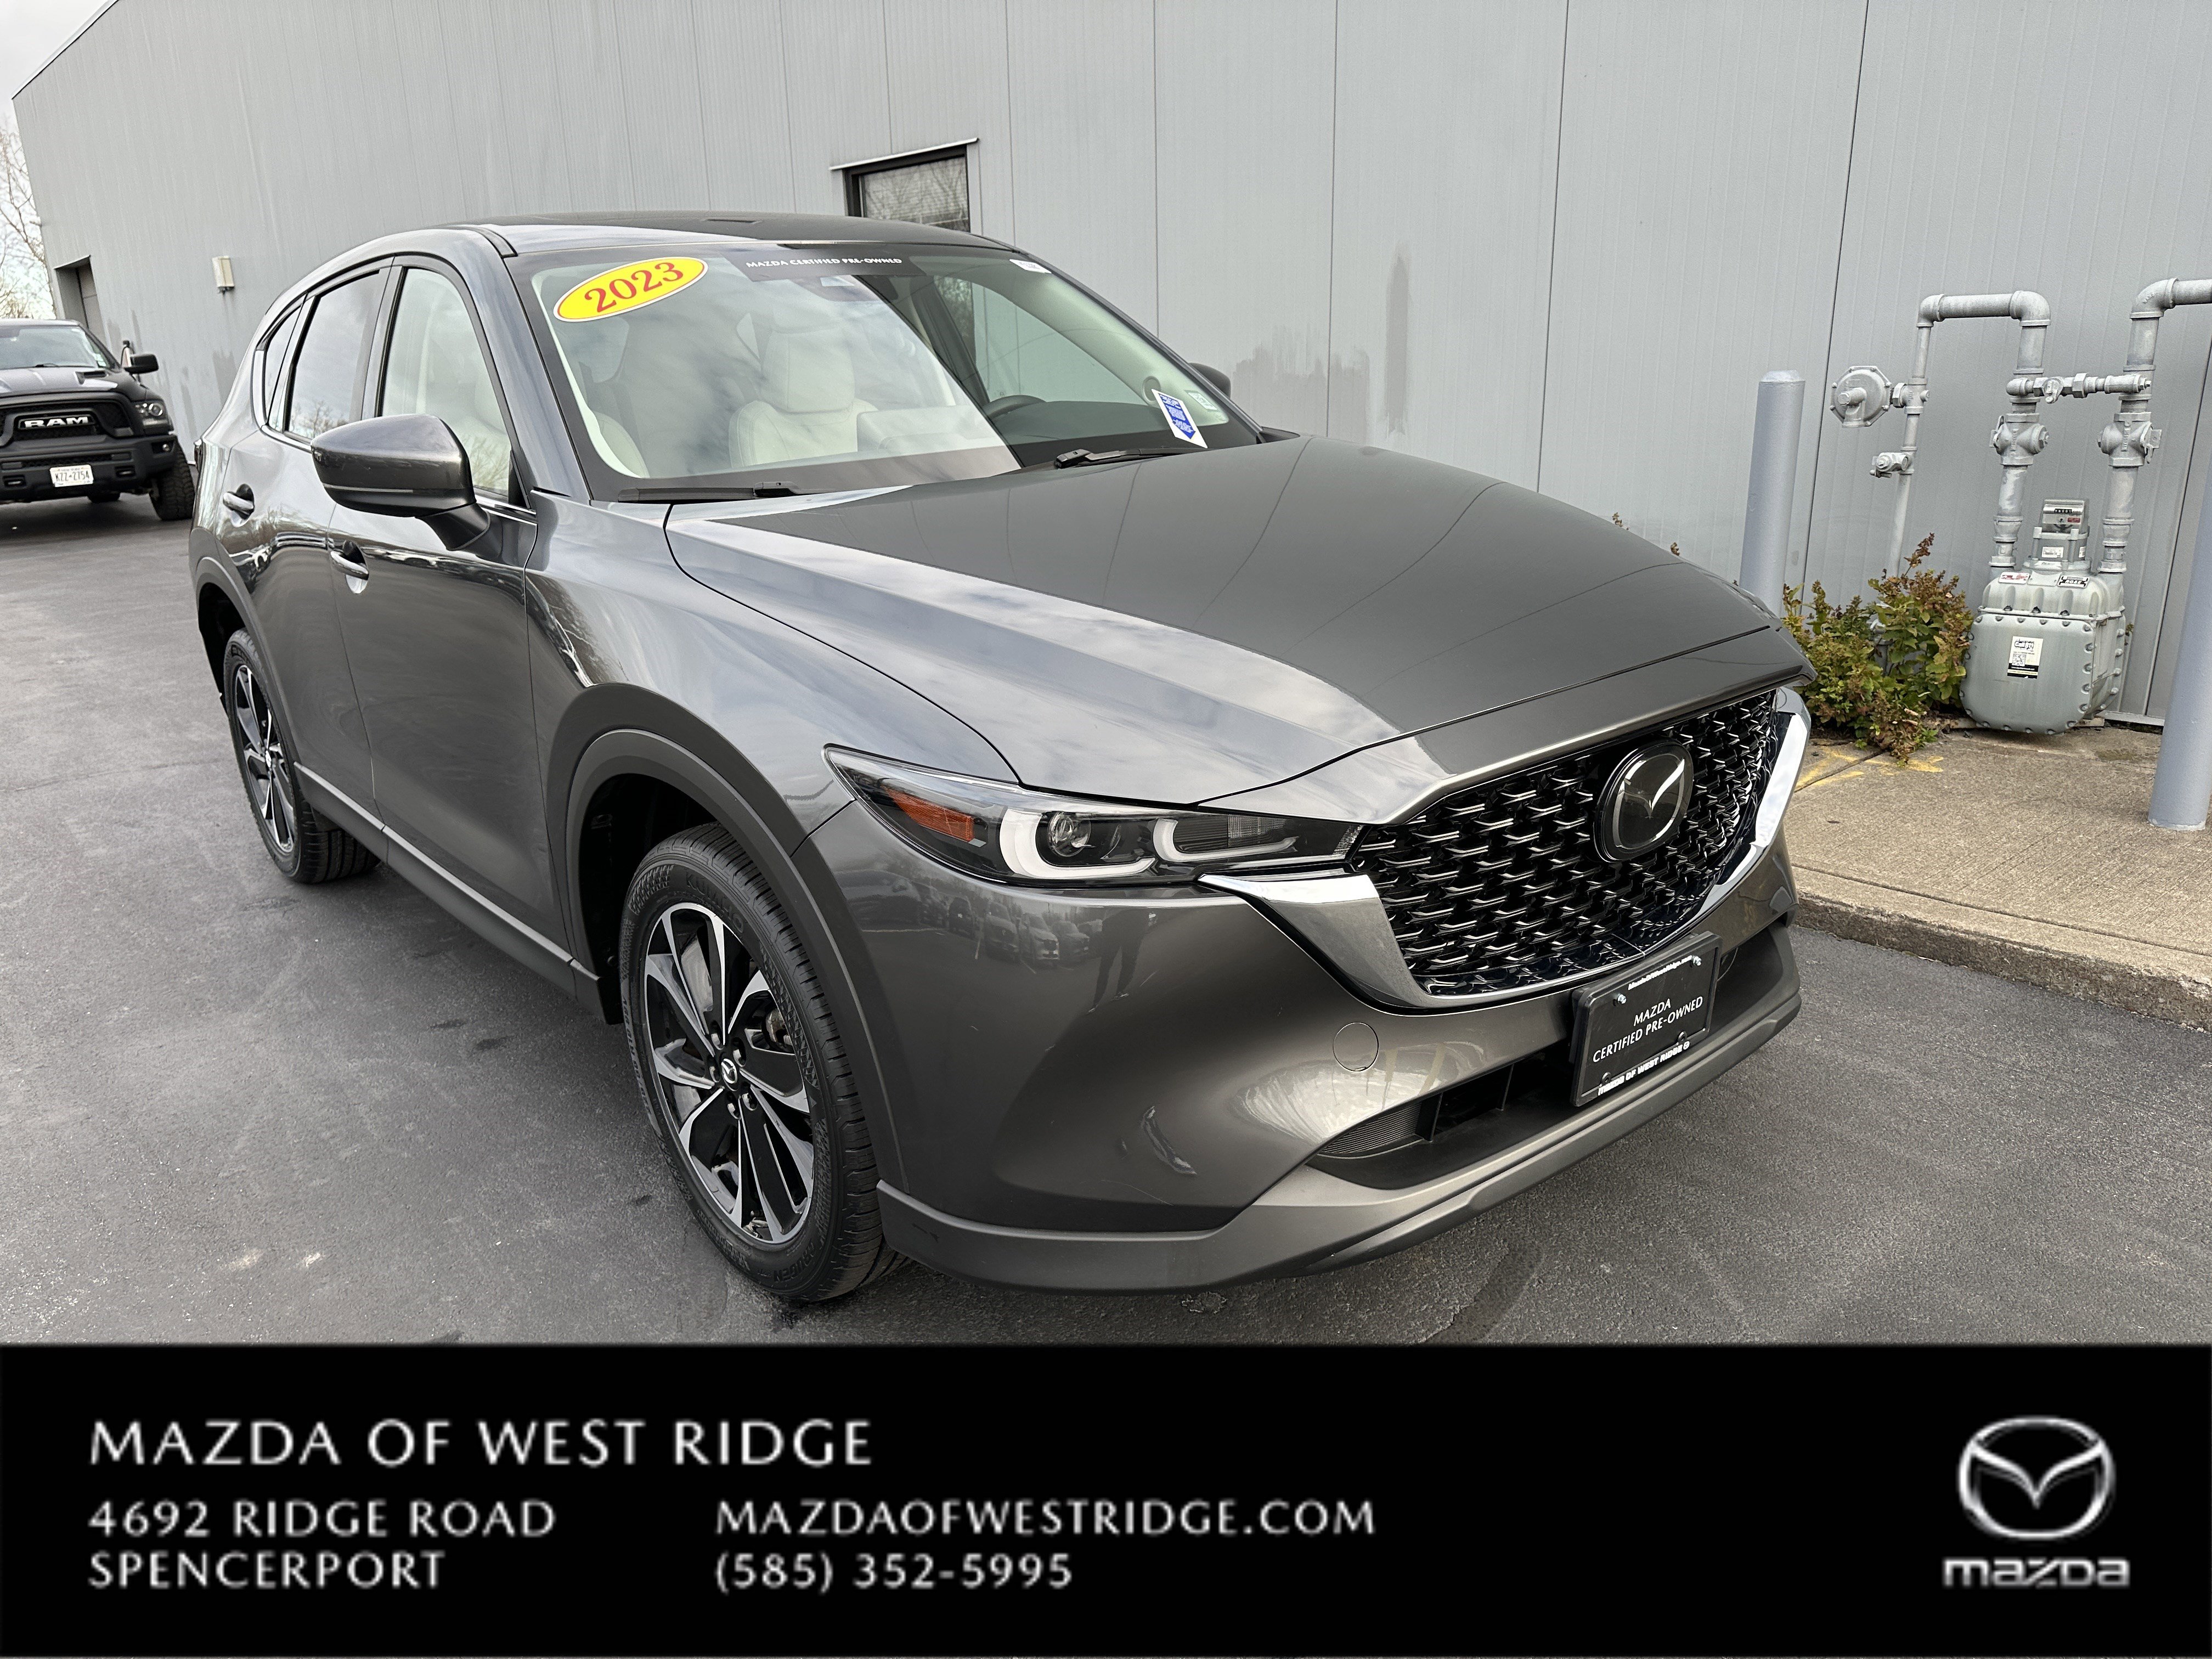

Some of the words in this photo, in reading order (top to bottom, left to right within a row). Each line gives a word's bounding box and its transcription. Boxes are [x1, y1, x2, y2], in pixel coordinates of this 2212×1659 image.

[584, 262, 684, 313] 2023
[24, 416, 88, 428] RAM
[1593, 1028, 1643, 1063] CERTIFIED
[1645, 996, 1703, 1036] PRE-OWNED
[1633, 998, 1671, 1026] MAZDA
[1626, 1069, 1637, 1081] OF
[1638, 1056, 1660, 1075] WEST
[1660, 1044, 1683, 1063] RIDGE
